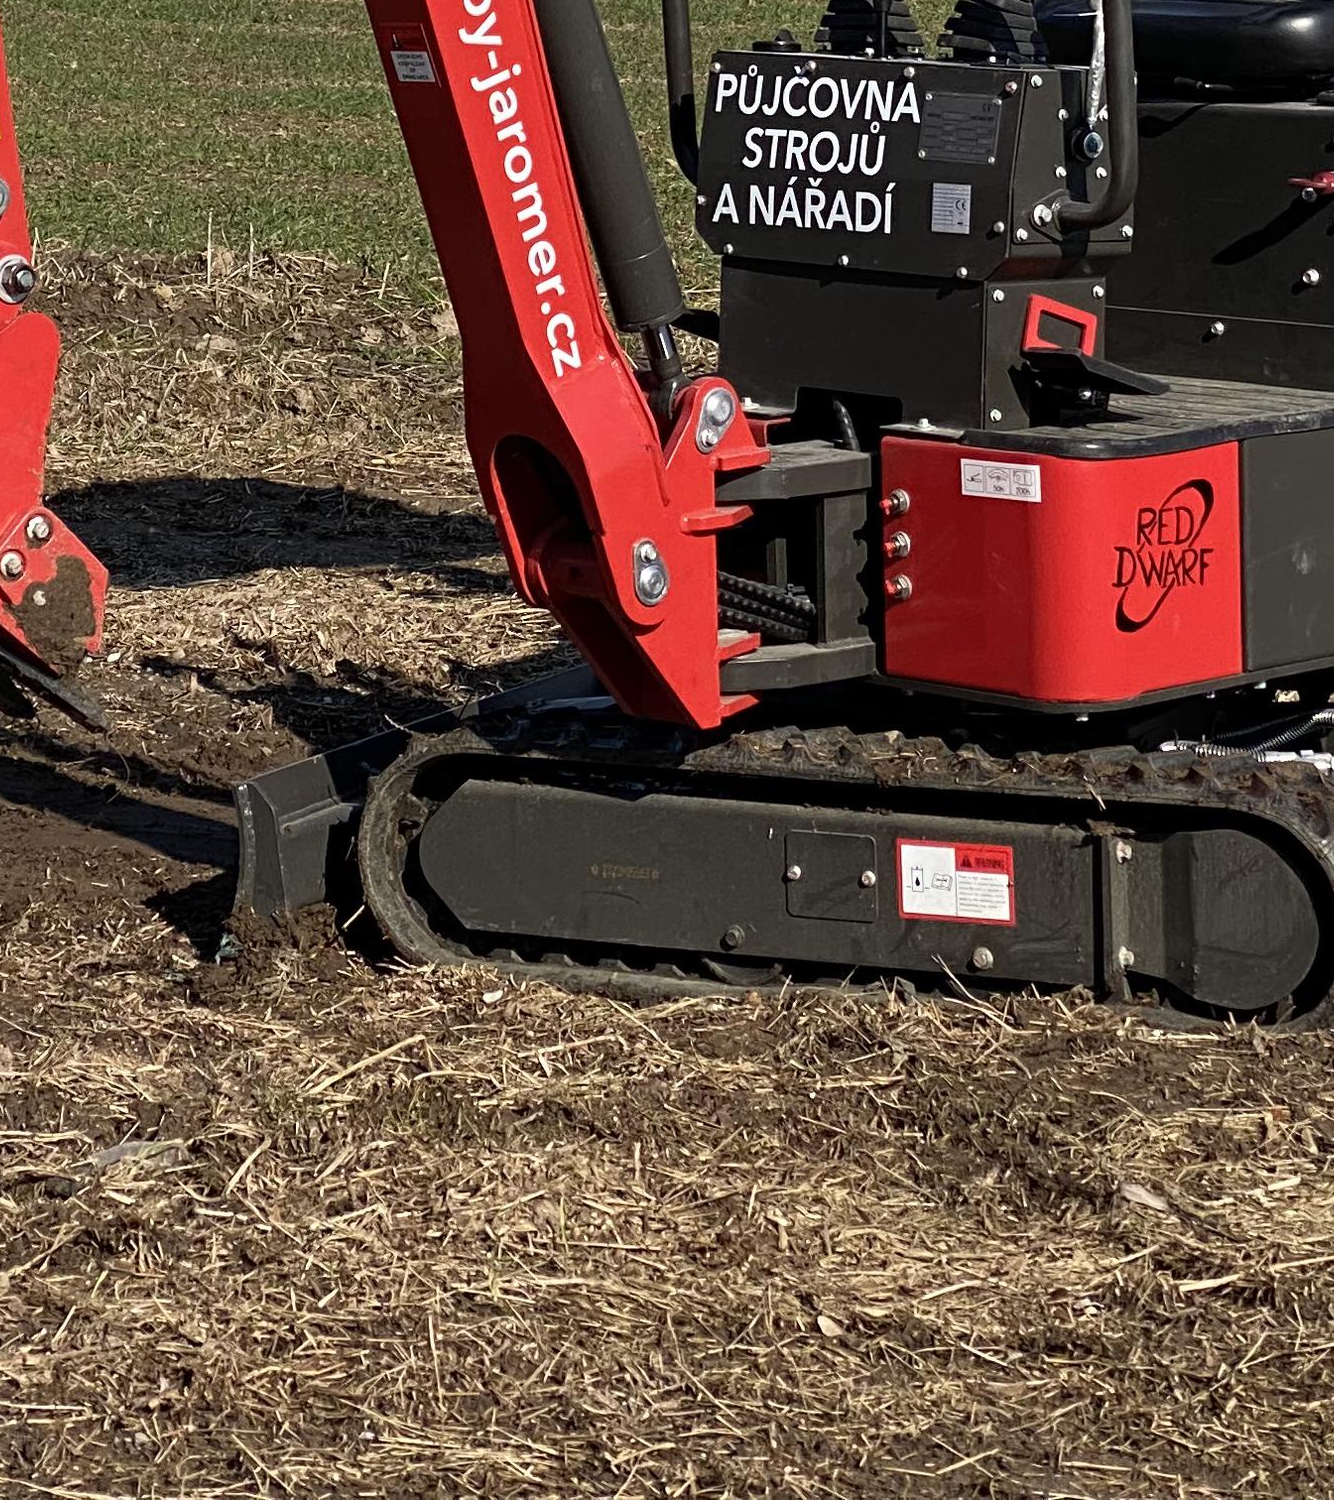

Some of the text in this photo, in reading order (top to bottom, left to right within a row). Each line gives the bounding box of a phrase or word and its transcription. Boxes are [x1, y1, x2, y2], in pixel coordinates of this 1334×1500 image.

[714, 64, 921, 124] PŮJČOVNA
[742, 121, 886, 176] STROJŮ
[712, 183, 739, 224] A
[749, 176, 896, 234] NÁŘADÍ
[1137, 506, 1195, 546] RED
[1111, 546, 1215, 589] DWARF
